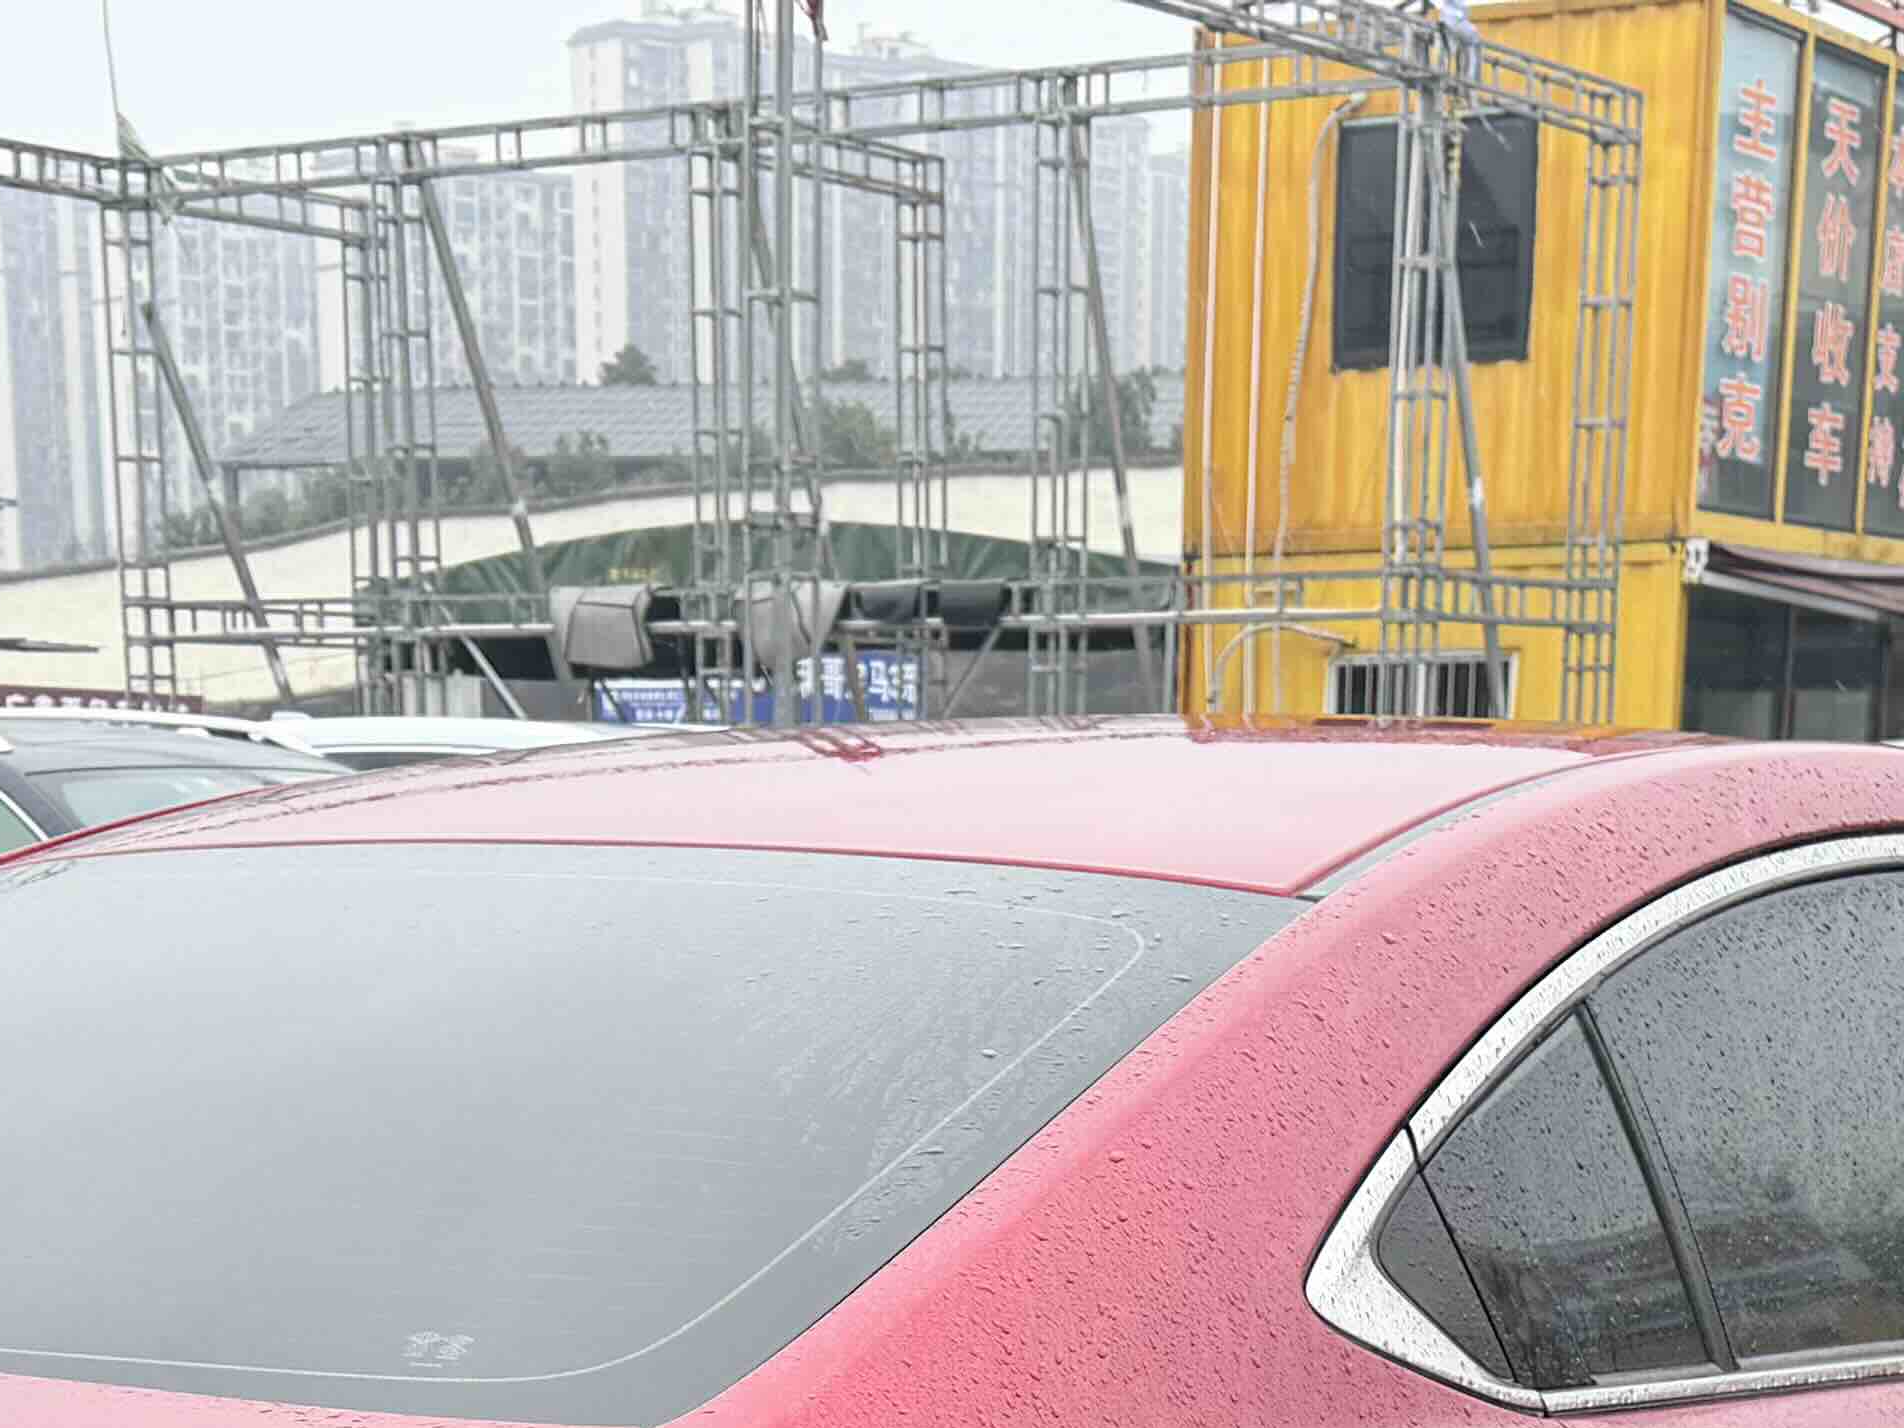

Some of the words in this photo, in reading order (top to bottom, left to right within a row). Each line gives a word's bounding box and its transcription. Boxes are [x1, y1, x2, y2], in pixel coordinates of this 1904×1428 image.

[1716, 80, 1777, 464] 主营别克
[1805, 97, 1862, 486] 天价收车
